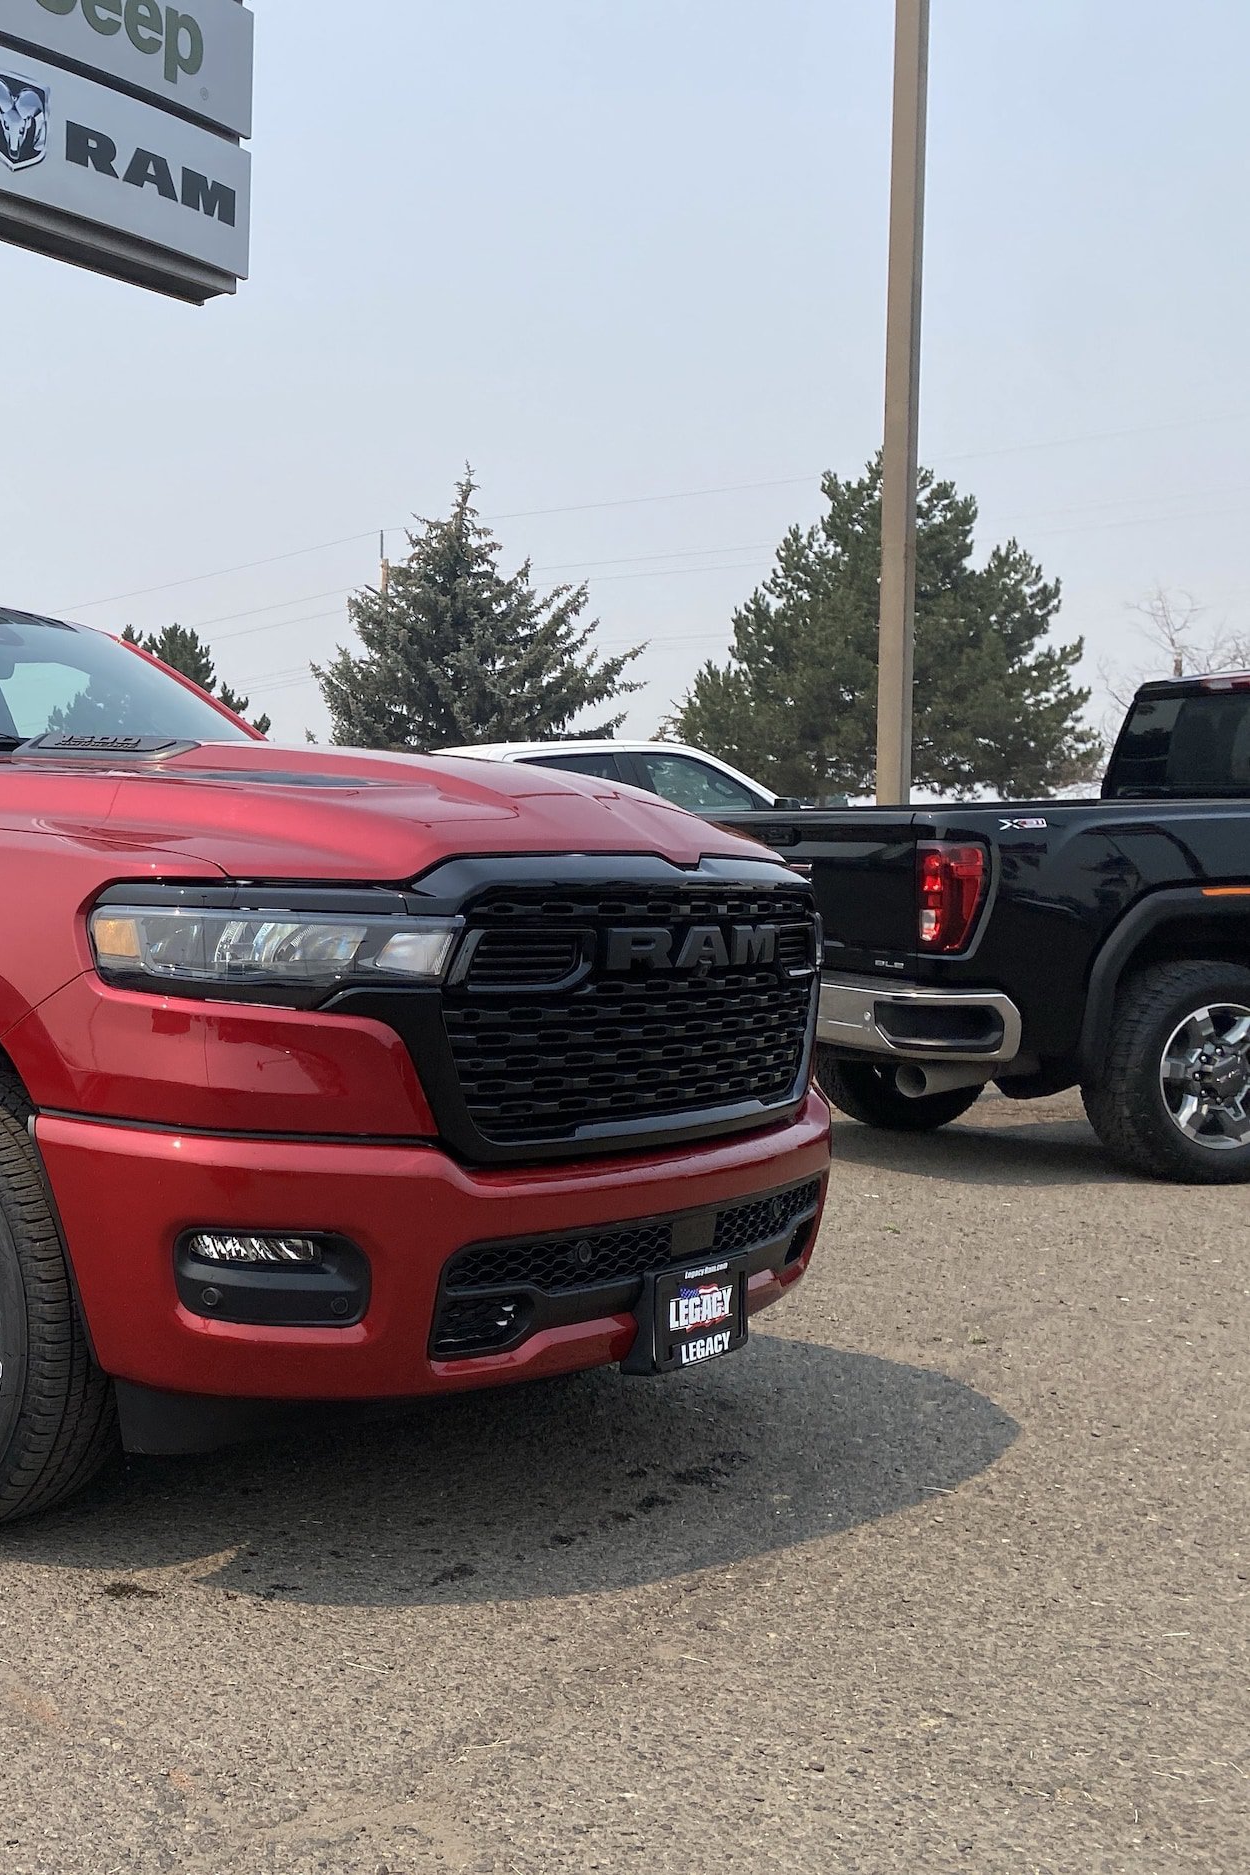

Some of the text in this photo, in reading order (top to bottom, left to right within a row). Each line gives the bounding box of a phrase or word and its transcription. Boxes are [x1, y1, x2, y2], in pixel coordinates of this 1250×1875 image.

[36, 0, 204, 84] eep
[65, 119, 236, 227] RAM
[606, 924, 777, 971] RAM
[670, 1287, 732, 1329] LEGACY
[681, 1331, 731, 1364] LEGACY
